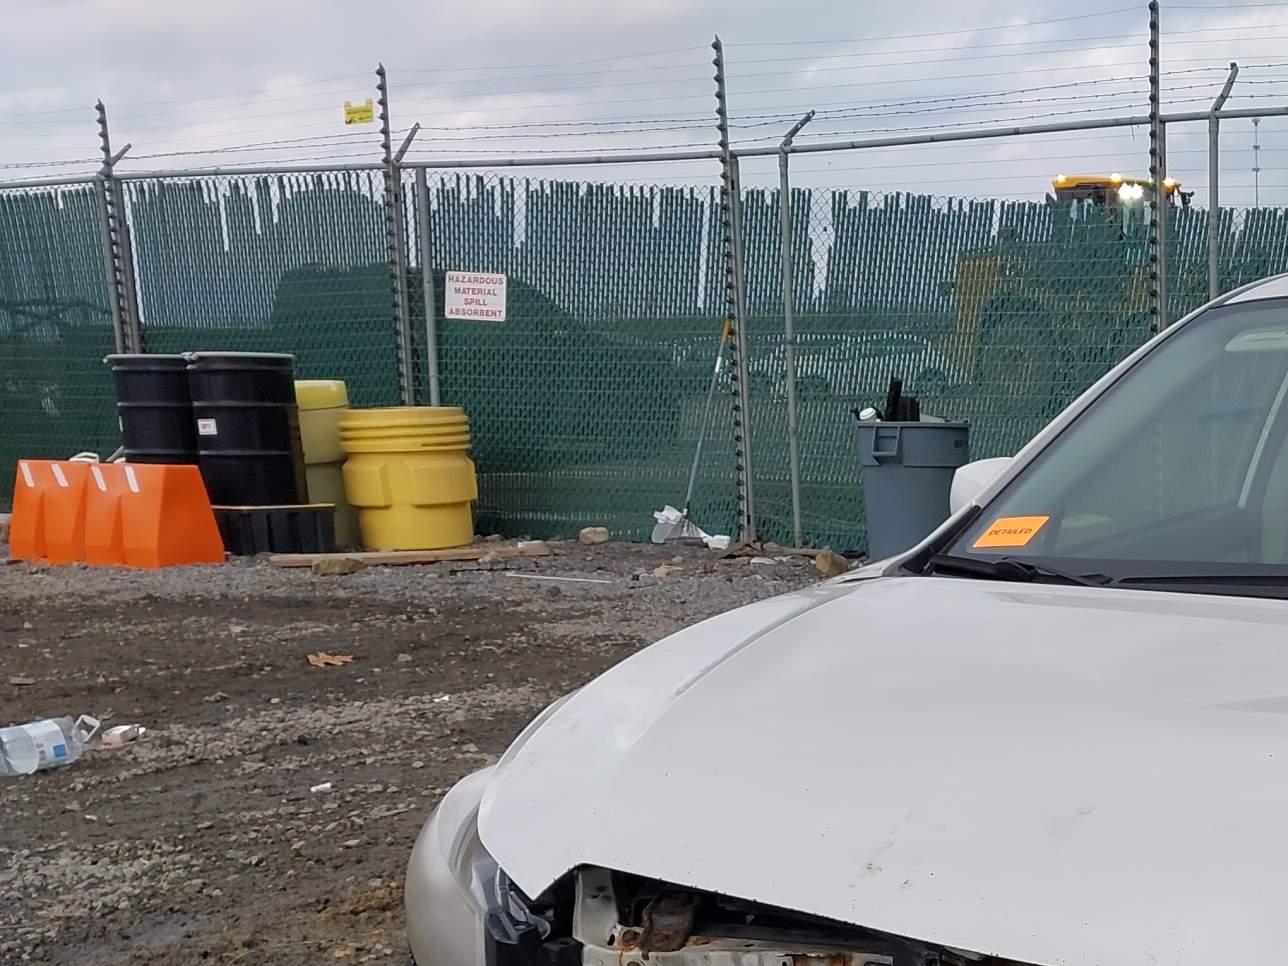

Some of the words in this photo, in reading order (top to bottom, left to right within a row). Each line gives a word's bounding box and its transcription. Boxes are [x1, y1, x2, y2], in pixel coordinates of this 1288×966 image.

[447, 275, 504, 285] HAZARDOUS
[454, 286, 498, 296] MATERIAL
[463, 297, 488, 306] SPILL
[448, 307, 503, 317] ABSORBENT
